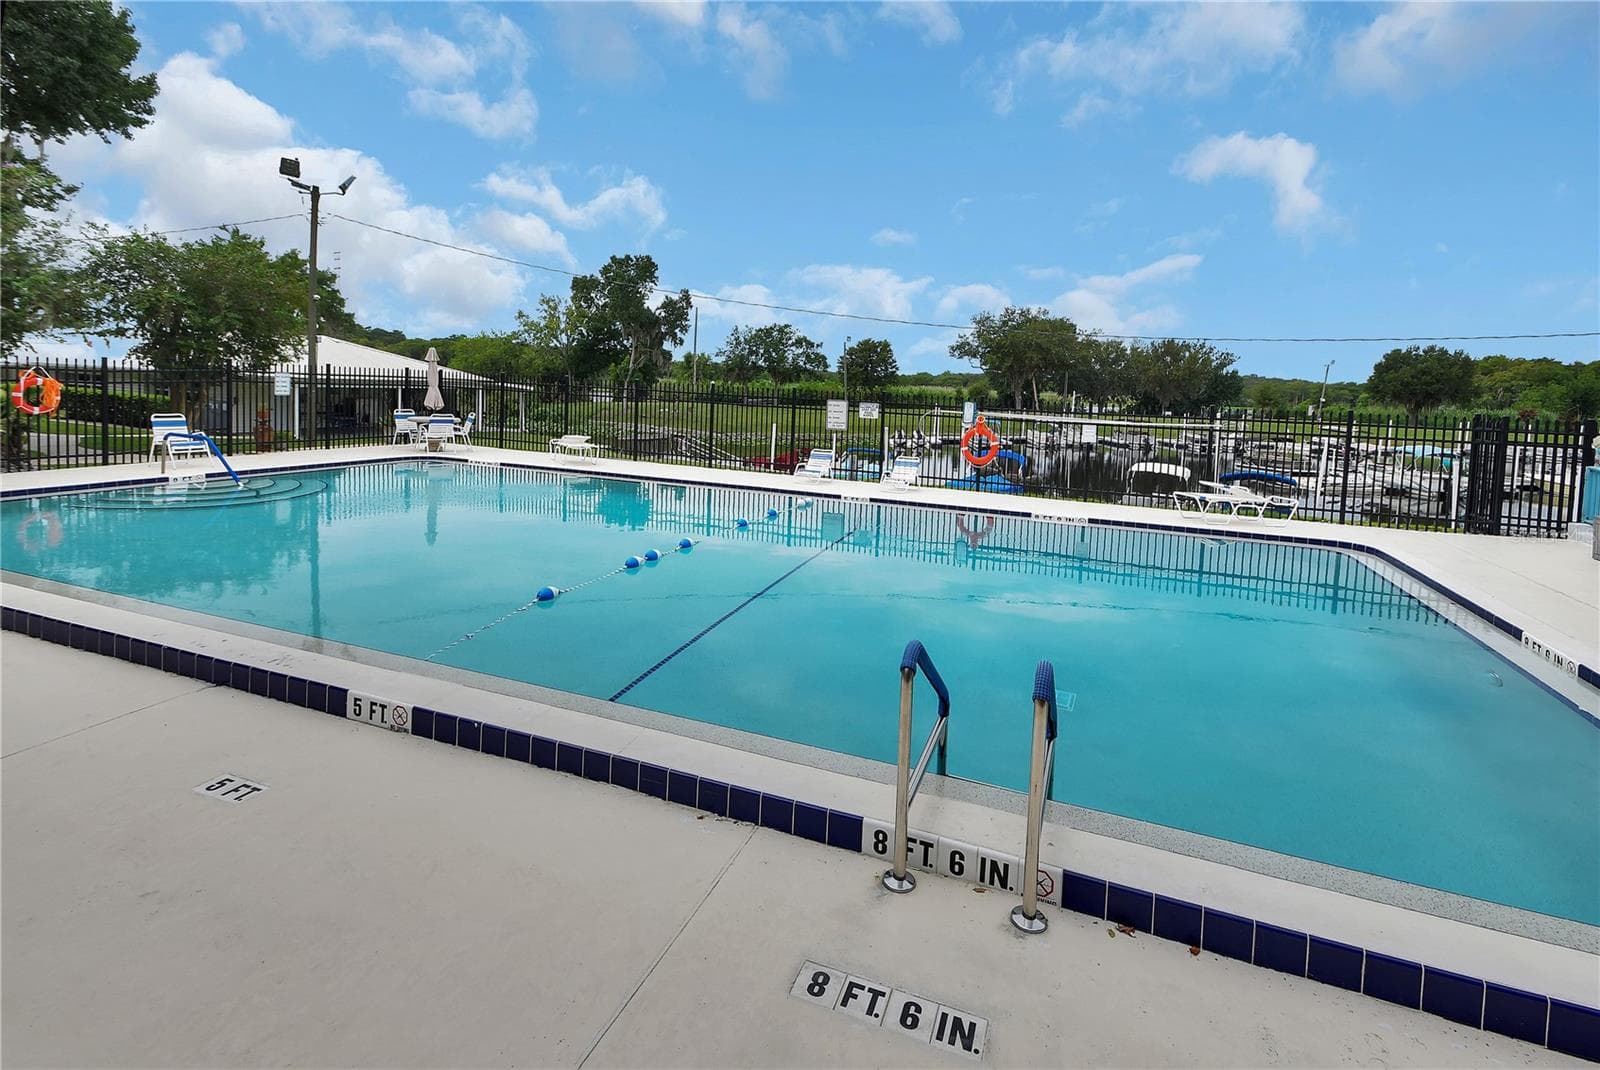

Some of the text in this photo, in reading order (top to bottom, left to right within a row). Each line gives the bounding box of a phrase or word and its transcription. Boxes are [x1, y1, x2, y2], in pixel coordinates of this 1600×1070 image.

[353, 697, 388, 724] 5 FT.
[205, 778, 235, 791] 5
[873, 829, 888, 855] 8
[949, 850, 965, 876] 6
[979, 857, 1014, 892] IN.
[806, 971, 980, 1055] 8 FT. 6 IN.
